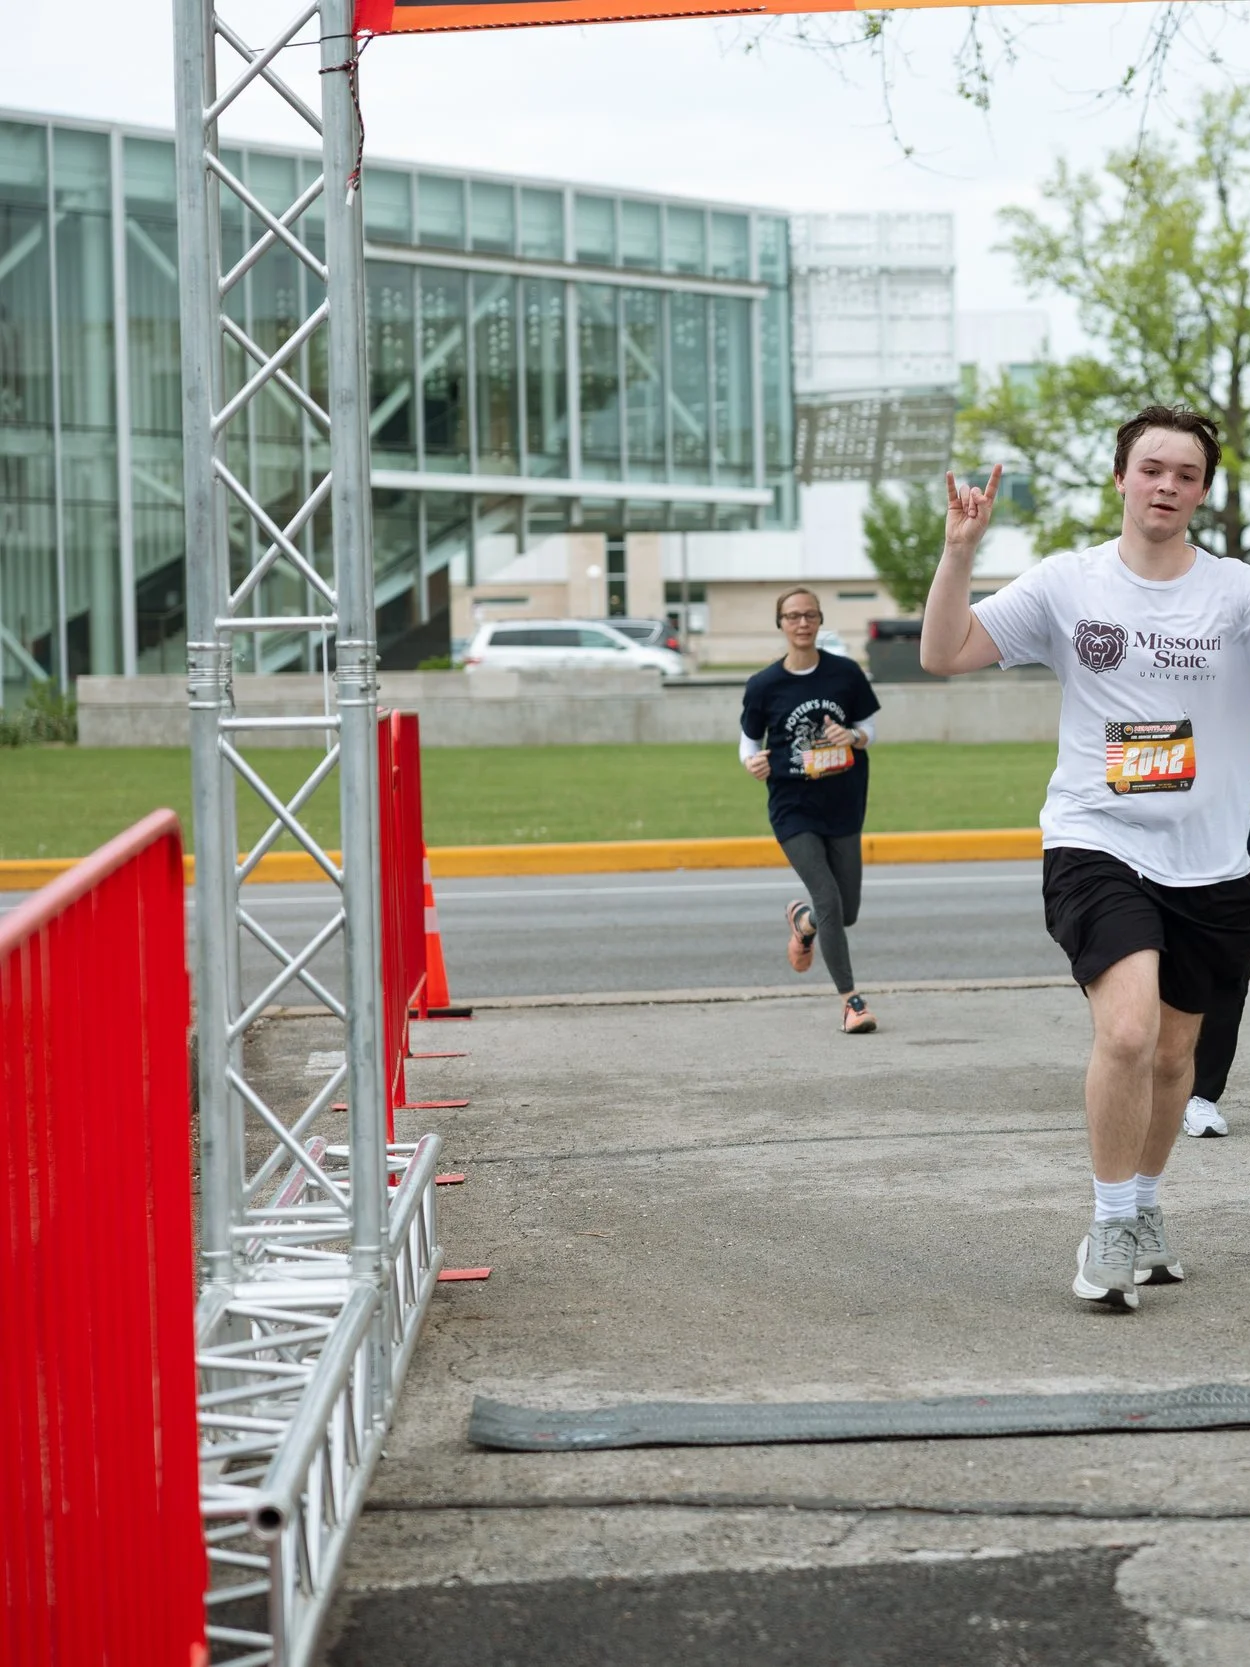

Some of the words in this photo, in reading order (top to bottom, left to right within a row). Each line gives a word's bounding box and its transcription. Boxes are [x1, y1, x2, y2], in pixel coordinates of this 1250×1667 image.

[1133, 631, 1221, 650] Missouri
[1153, 650, 1207, 668] State
[1140, 671, 1217, 681] UNIVERSITY
[785, 699, 820, 731] POTTER'S
[1122, 744, 1186, 777] 2042
